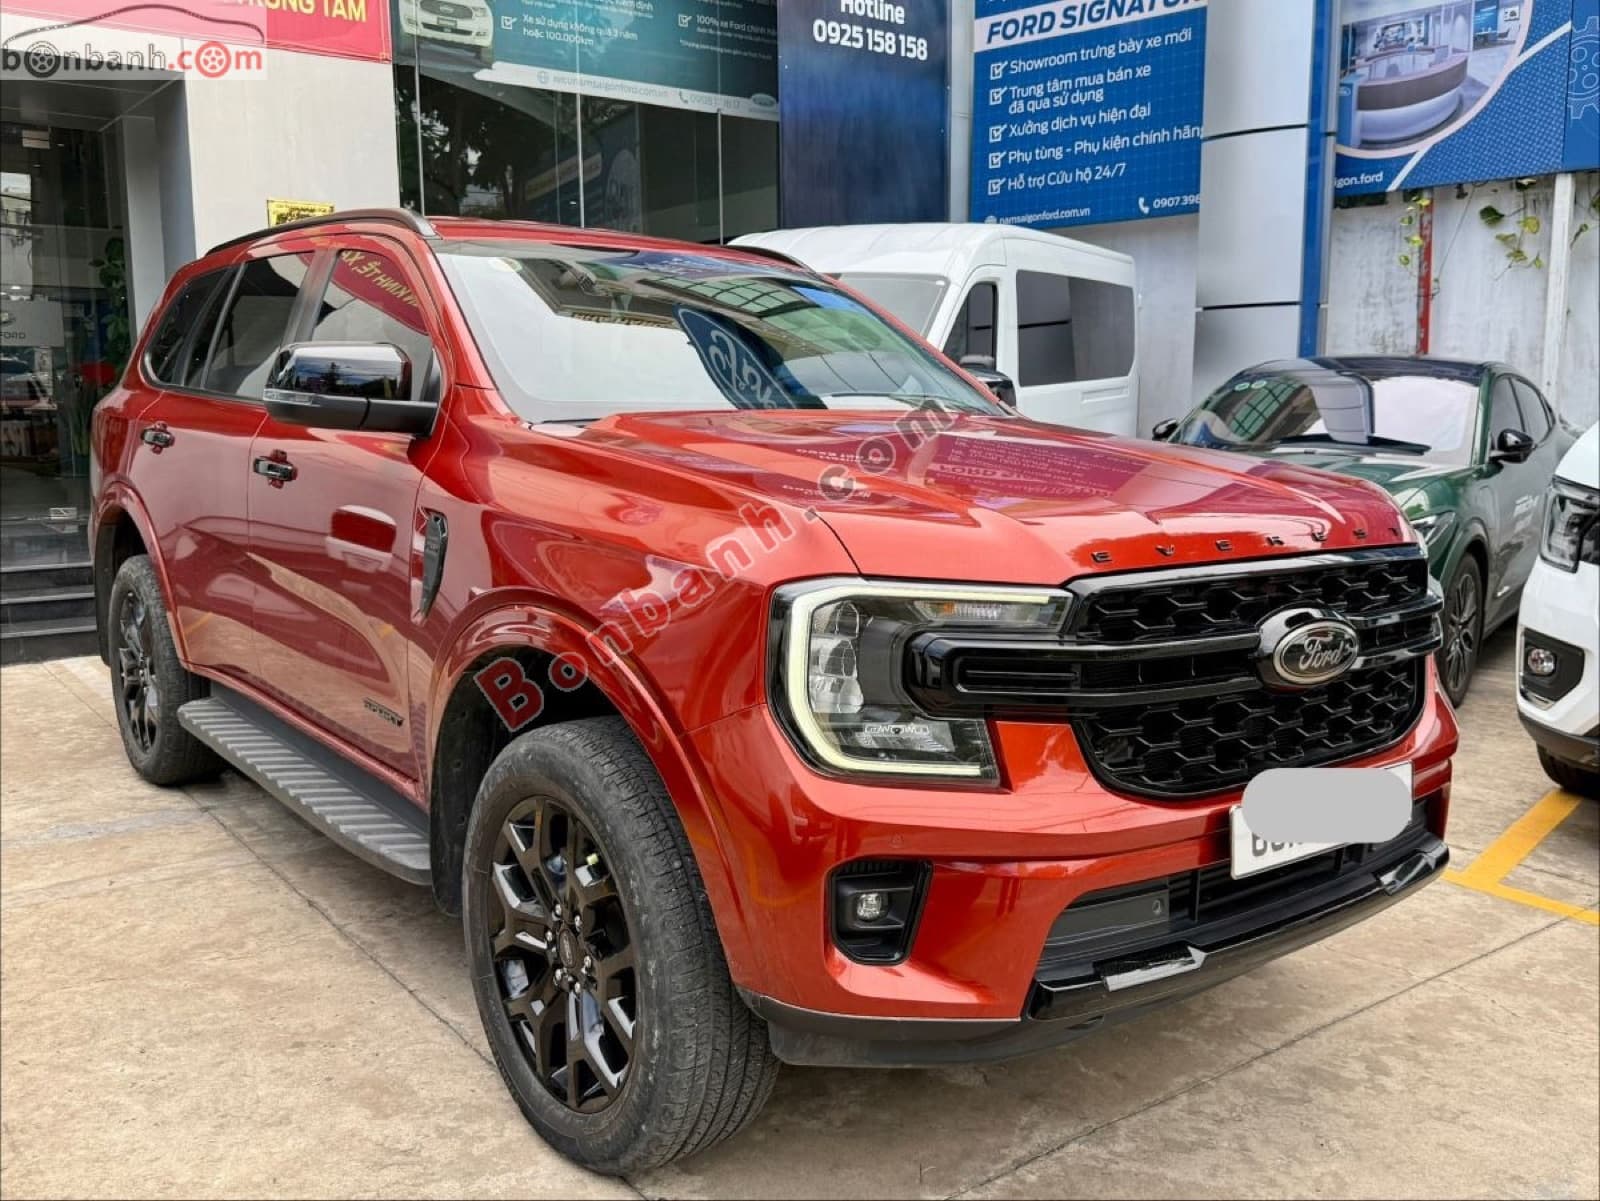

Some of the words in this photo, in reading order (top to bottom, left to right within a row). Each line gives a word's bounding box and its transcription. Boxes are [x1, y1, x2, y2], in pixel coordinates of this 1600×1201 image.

[841, 0, 905, 24] Hotline
[986, 12, 1056, 44] FORD
[1060, 0, 1201, 30] SIGNA
[813, 19, 864, 49] 0925
[866, 28, 896, 55] 158
[898, 34, 928, 61] 158
[1009, 54, 1078, 74] Showroom
[1080, 44, 1116, 59] trưng
[1118, 38, 1144, 54] bày
[1145, 35, 1162, 48] xe
[1164, 27, 1192, 46] mới
[1009, 83, 1044, 99] Trung
[1047, 78, 1072, 93] tâm
[1075, 73, 1104, 88] mua
[1107, 66, 1132, 83] bán
[1135, 64, 1152, 78] xe
[1009, 99, 1025, 115] đã
[1027, 97, 1050, 113] qua
[1052, 91, 1070, 107] sử
[1070, 88, 1104, 105] dụng
[1009, 120, 1048, 137] Xưởng
[1051, 114, 1077, 132] dịch
[1080, 114, 1097, 128] vụ
[1098, 107, 1128, 125] hiện
[1129, 102, 1152, 120] đại
[1008, 150, 1033, 165] Phụ
[1035, 145, 1064, 161] tùng
[1074, 141, 1101, 156] Phụ
[1102, 135, 1131, 154] kiện
[1132, 129, 1171, 147] chính
[1008, 173, 1025, 191] Hỗ
[1027, 174, 1046, 189] trợ
[1047, 169, 1073, 186] Cứu
[1075, 168, 1092, 184] hộ
[1095, 162, 1127, 180] 24/7
[999, 207, 1091, 225] namsaigonford.com.vn
[1092, 527, 1399, 563] EVEREST
[1299, 629, 1348, 671] Ford
